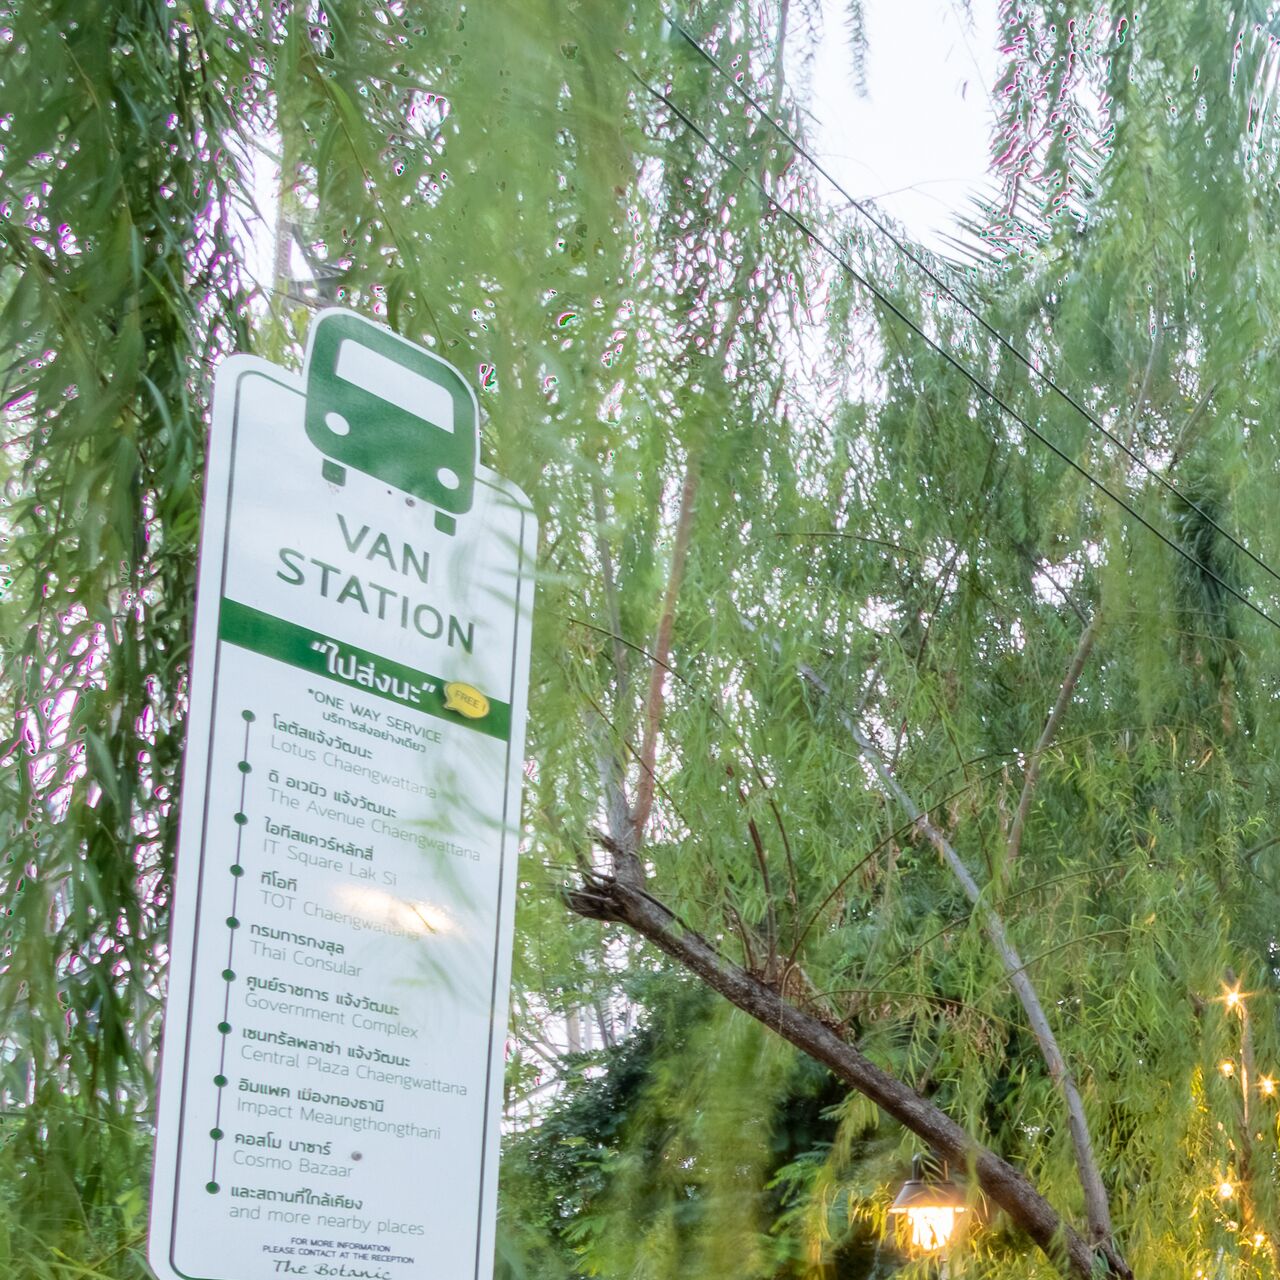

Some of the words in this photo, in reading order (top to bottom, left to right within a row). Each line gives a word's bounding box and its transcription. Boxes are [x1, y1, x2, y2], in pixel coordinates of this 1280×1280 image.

[336, 513, 430, 584] VAN
[276, 547, 474, 654] STATION
[454, 690, 480, 709] FREE
[272, 714, 373, 760] โลตัสแจ้งวัฒนะ
[322, 710, 427, 753] บริการส่งอย่างเดียว
[350, 702, 381, 721] WAY
[386, 715, 443, 744] SERVICE
[271, 736, 317, 761] Lotus
[322, 751, 437, 800] Chaengwattana
[285, 775, 327, 798] อเวนิว
[334, 788, 397, 818] แจ้งวัฒนะ
[264, 817, 374, 862] ไอทีสแควร์หลักสี่
[267, 787, 300, 810] The
[306, 799, 366, 829] Avenue
[370, 819, 481, 862] Chaengwattana
[260, 871, 298, 893] ทีโอที
[263, 838, 281, 856] IT
[287, 845, 344, 873] Square
[350, 860, 377, 881] Lak
[383, 869, 398, 887] Si
[259, 889, 297, 911] TOT
[249, 938, 287, 962] Thai
[293, 949, 363, 978] Consular
[250, 922, 345, 957] กรมการกงสุล
[245, 992, 345, 1026] Government
[352, 1013, 419, 1040] Complex
[246, 974, 330, 1002] ศูนย์ราชการ
[336, 993, 400, 1017] แจ้งวัฒนะ
[242, 1026, 341, 1056] เซนทรัลพลาซ่า
[347, 1044, 411, 1067] แจ้งวัฒนะ
[240, 1045, 300, 1069] Central
[307, 1056, 350, 1077] Plaza
[355, 1065, 468, 1097] Chaengwattana
[238, 1077, 291, 1099] อิมแพค
[297, 1088, 385, 1113] เมืองทองธานี
[237, 1097, 293, 1121] Impact
[300, 1107, 441, 1141] Meaungthongthani
[232, 1150, 292, 1171] Cosmo
[299, 1158, 353, 1178] Bazaar
[234, 1132, 282, 1150] คอสโม
[289, 1141, 332, 1156] บาซาร์
[231, 1184, 364, 1211] และสถานที่ใกล้เคียง
[229, 1205, 260, 1220] and
[267, 1210, 311, 1225] more
[317, 1215, 372, 1234] nearby
[377, 1219, 425, 1236] places
[262, 1245, 296, 1256] PLEASE
[298, 1248, 337, 1259] CONTACT
[339, 1251, 350, 1259] AT
[352, 1252, 369, 1261] THE
[371, 1253, 415, 1264] RECEPTION
[291, 1237, 308, 1246] FOR
[310, 1239, 334, 1248] MORE
[337, 1241, 391, 1253] INFORMATION
[272, 1259, 308, 1275] The
[314, 1262, 392, 1280] Botanic
